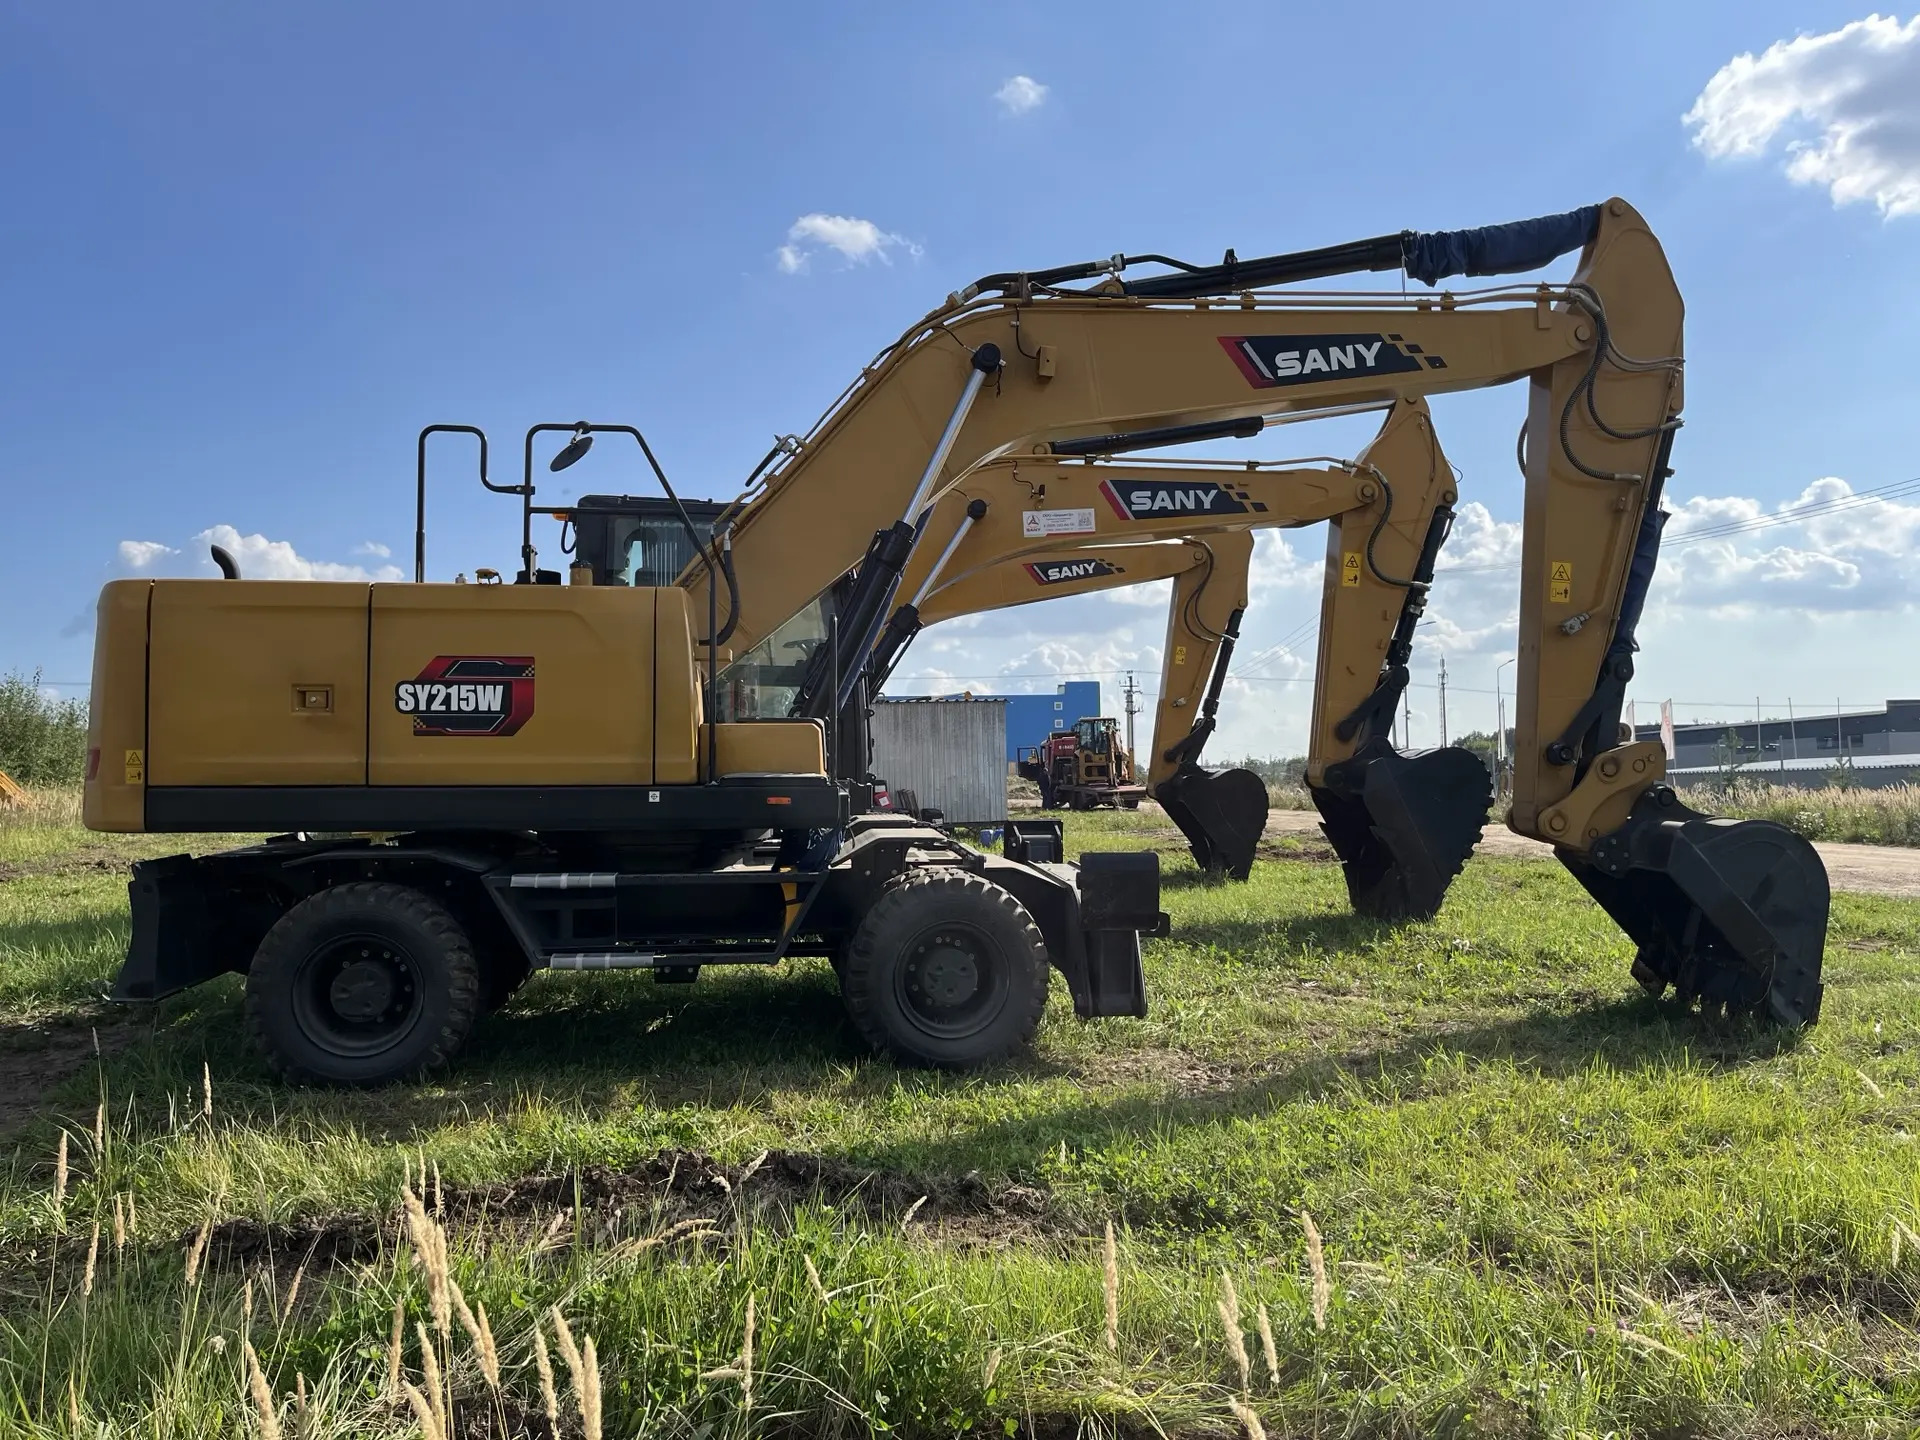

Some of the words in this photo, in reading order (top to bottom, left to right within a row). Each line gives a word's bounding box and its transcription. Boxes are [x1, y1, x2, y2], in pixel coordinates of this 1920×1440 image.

[1274, 341, 1383, 377] SANY
[1130, 489, 1219, 511] SANY
[1047, 561, 1096, 580] SANY
[398, 683, 504, 712] SY215W
